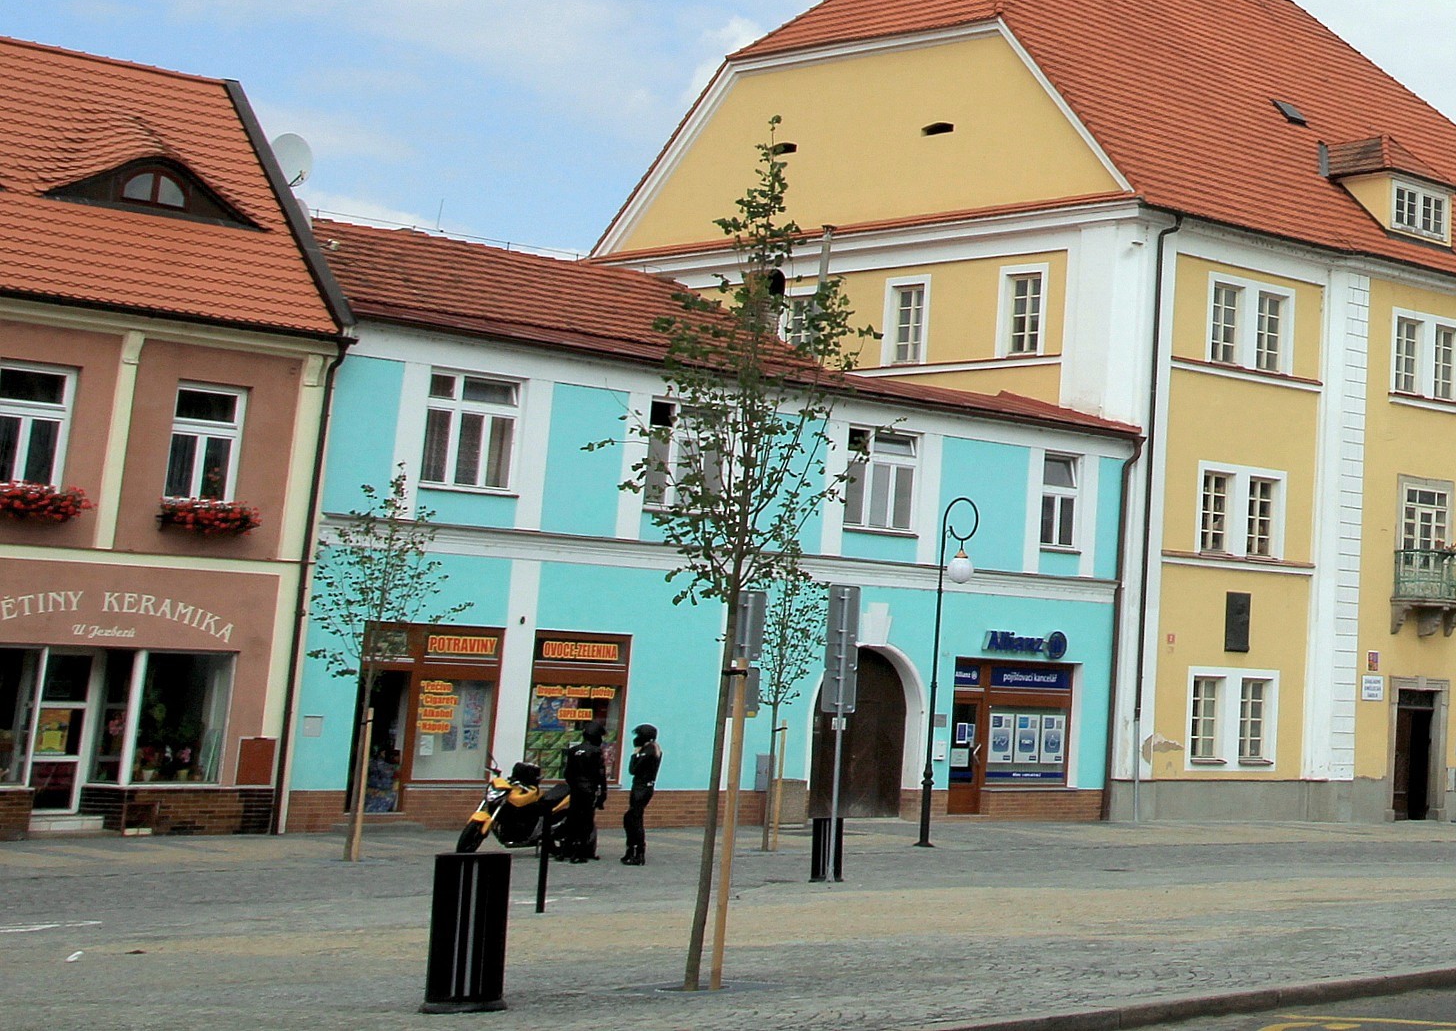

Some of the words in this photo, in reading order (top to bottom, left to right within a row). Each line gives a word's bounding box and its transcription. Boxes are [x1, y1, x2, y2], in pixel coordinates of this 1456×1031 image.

[101, 591, 235, 644] KERAMIKA
[72, 624, 85, 636] U
[428, 635, 498, 654] POTRAVINY
[543, 640, 619, 660] OVOCE-ZELENINA
[985, 630, 1045, 652] Allianz
[421, 708, 454, 720] Alkohol
[558, 708, 577, 720] SUPER
